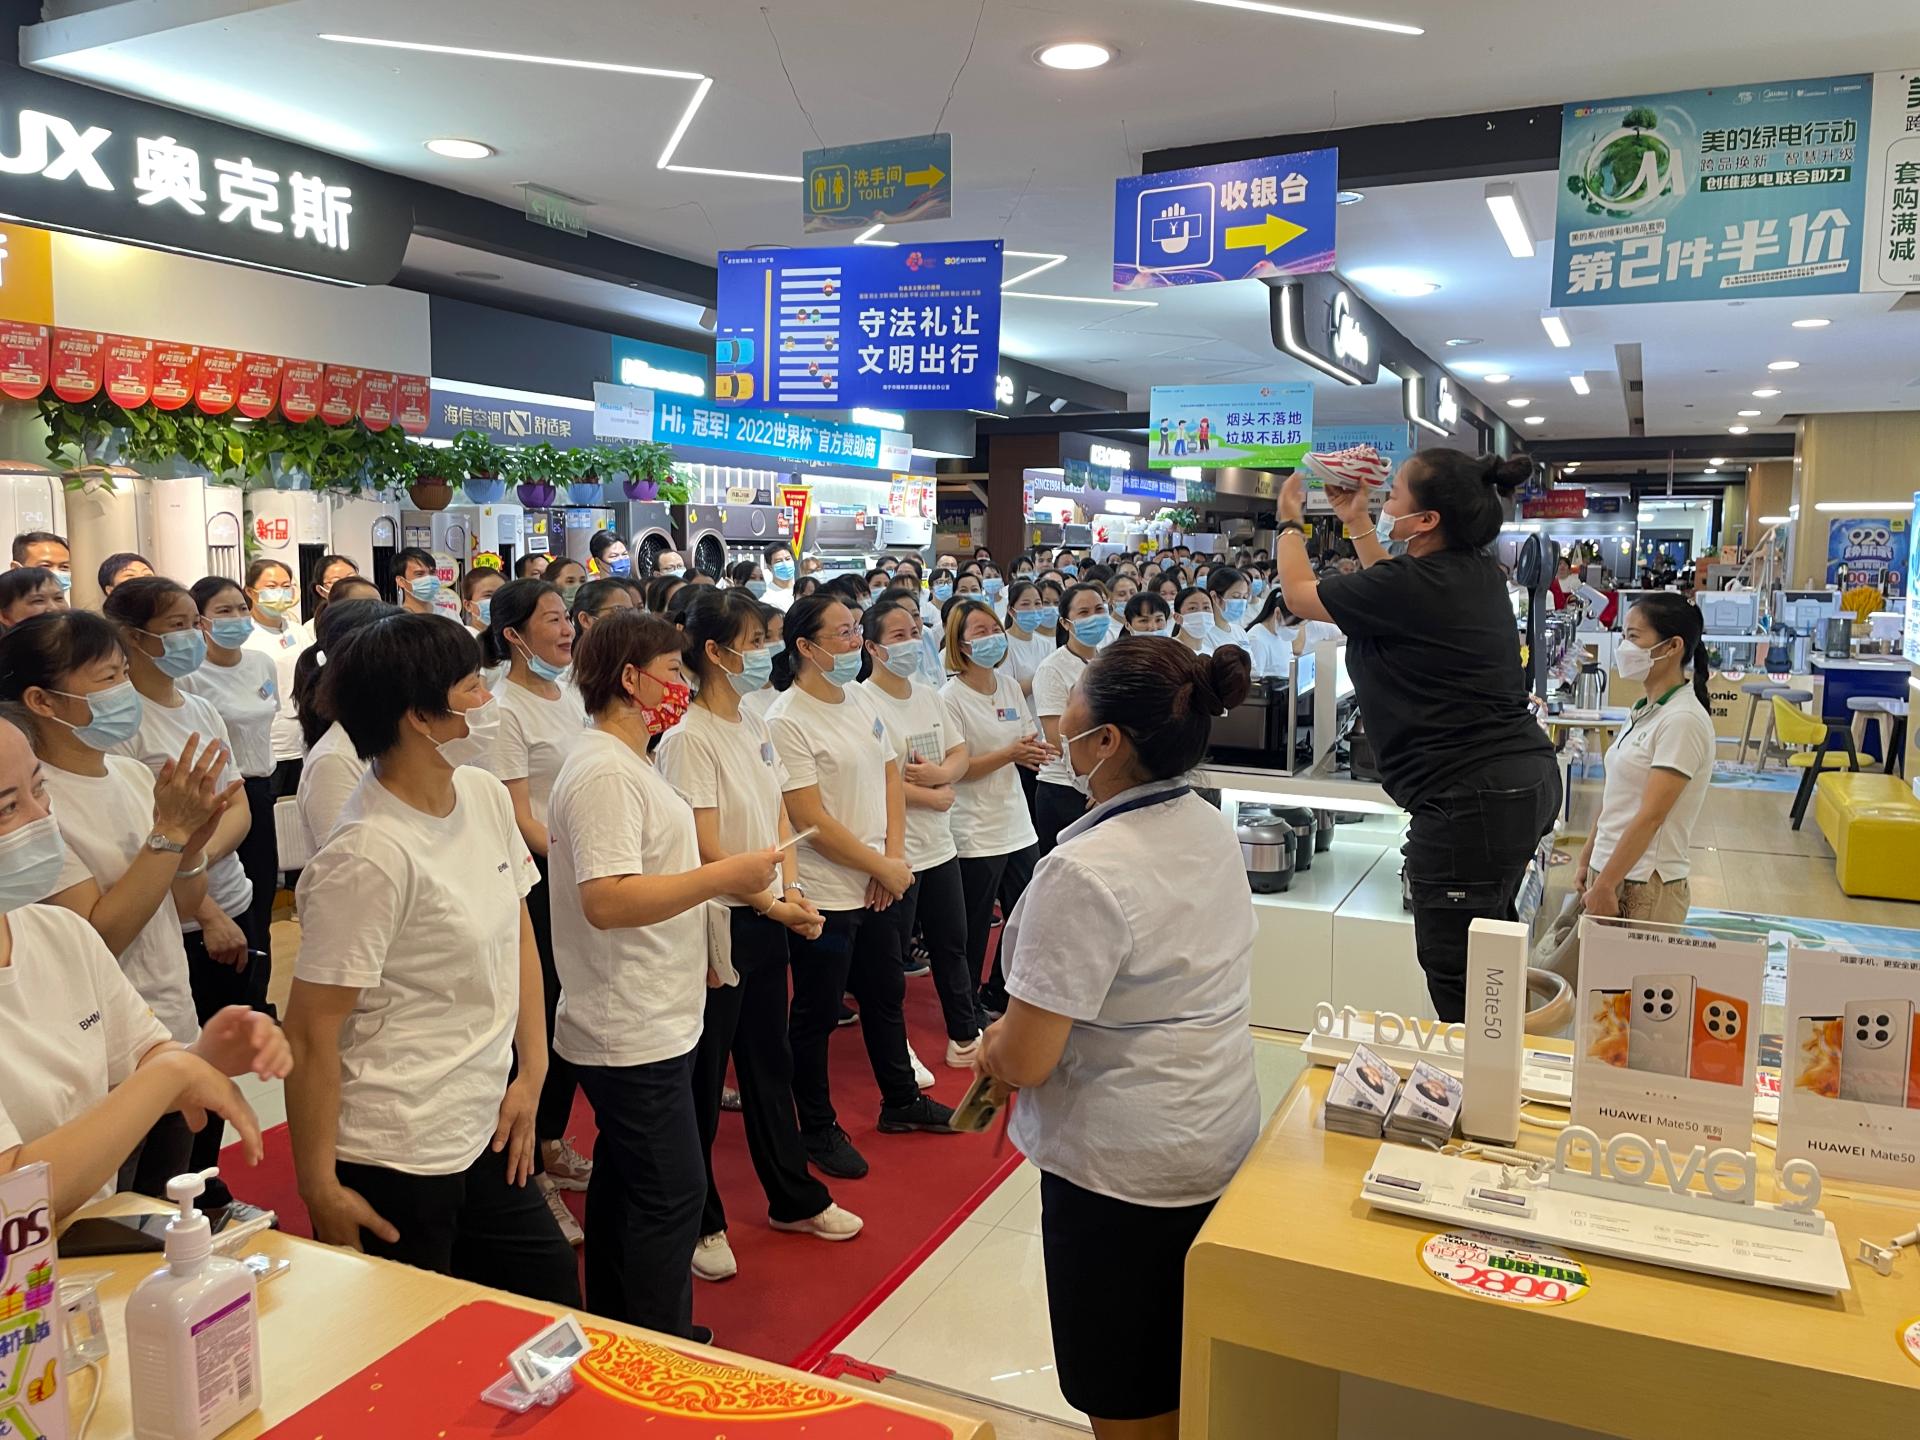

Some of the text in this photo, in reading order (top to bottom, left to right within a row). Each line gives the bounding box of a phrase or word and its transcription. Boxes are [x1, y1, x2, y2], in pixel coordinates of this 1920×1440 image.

[1701, 118, 1858, 154] 美的绿电行动
[1701, 148, 1855, 172] 跨品换新 智慧升级
[854, 165, 902, 188] 洗手间
[1221, 173, 1309, 211] 收银台
[1706, 168, 1846, 191] 创维彩电联合助力
[134, 136, 353, 251] 奥克斯
[859, 186, 896, 201] TOILET
[1888, 161, 1920, 262] 套购满减
[1566, 209, 1851, 295] 第2件半价
[858, 305, 980, 338] 守法礼让
[858, 343, 979, 375] 文明出行
[444, 405, 571, 438] 海信空调 舒适家
[1226, 411, 1302, 427] 烟头不落地
[1226, 430, 1301, 445] 垃圾不乱扔
[256, 518, 288, 540] 新品
[1848, 528, 1890, 546] 929
[1484, 967, 1504, 1039] Mate50
[1599, 1106, 1723, 1136] HUAWEI Mate50 系列
[1807, 1140, 1916, 1164] HUAWEI Mate50
[1555, 1125, 1822, 1211] nova 9
[1793, 1217, 1815, 1230] Series
[1451, 1263, 1568, 1303] 2899
